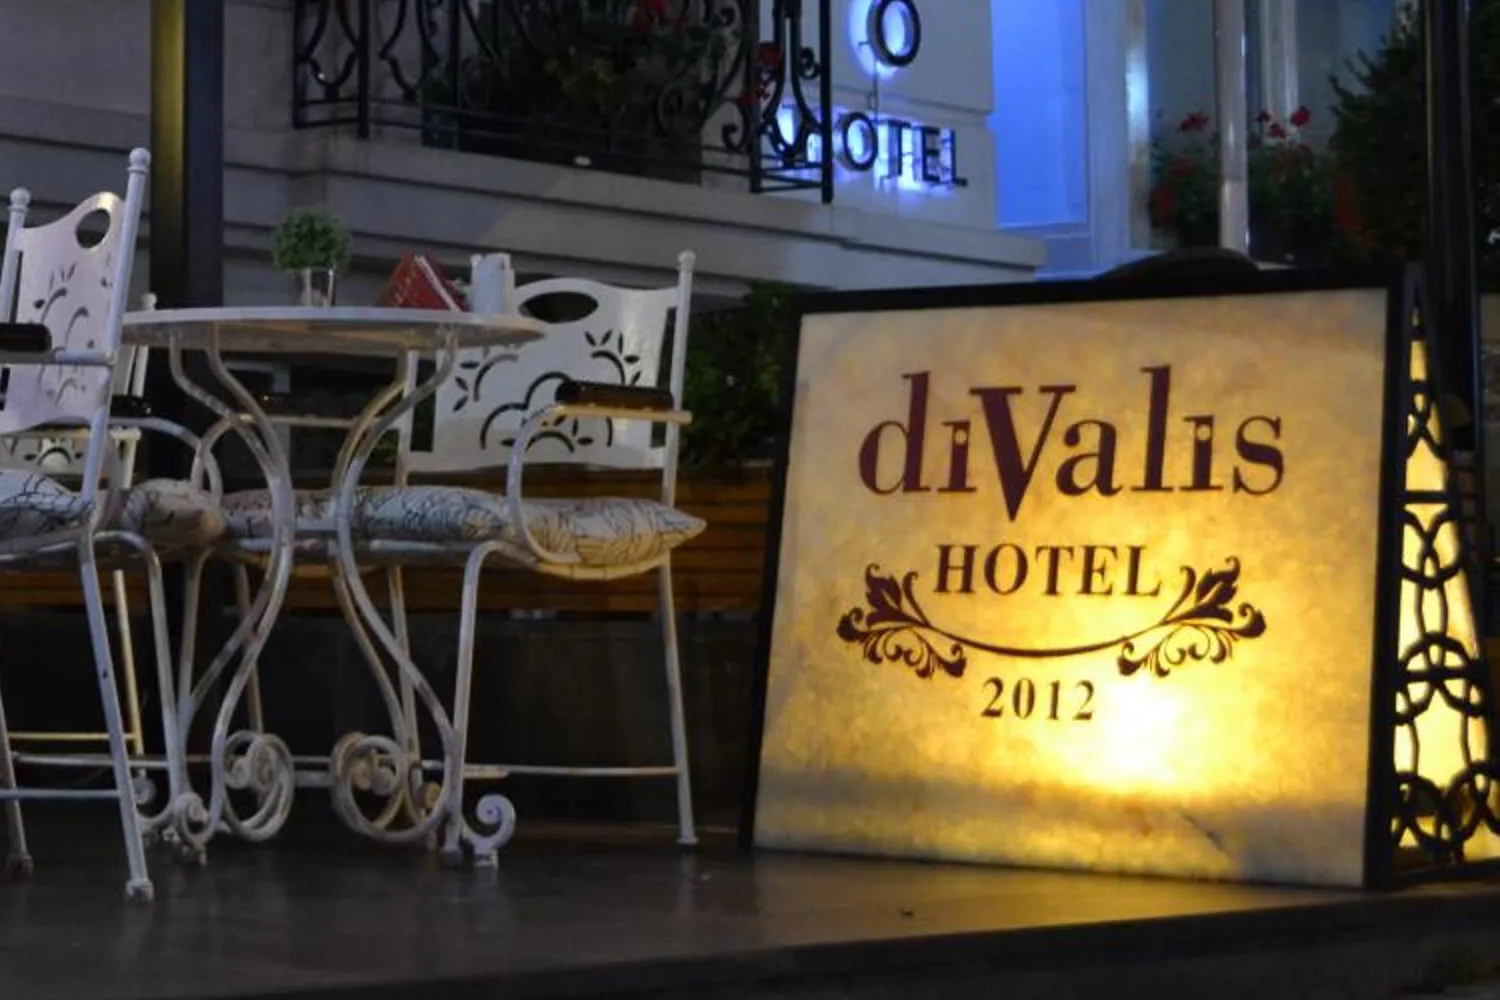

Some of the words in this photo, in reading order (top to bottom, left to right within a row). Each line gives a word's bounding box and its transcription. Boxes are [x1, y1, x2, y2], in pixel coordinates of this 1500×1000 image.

[793, 103, 968, 187] OTEL
[857, 363, 1287, 522] diValis
[932, 542, 1162, 598] HOTEL
[980, 676, 1096, 721] 2012
